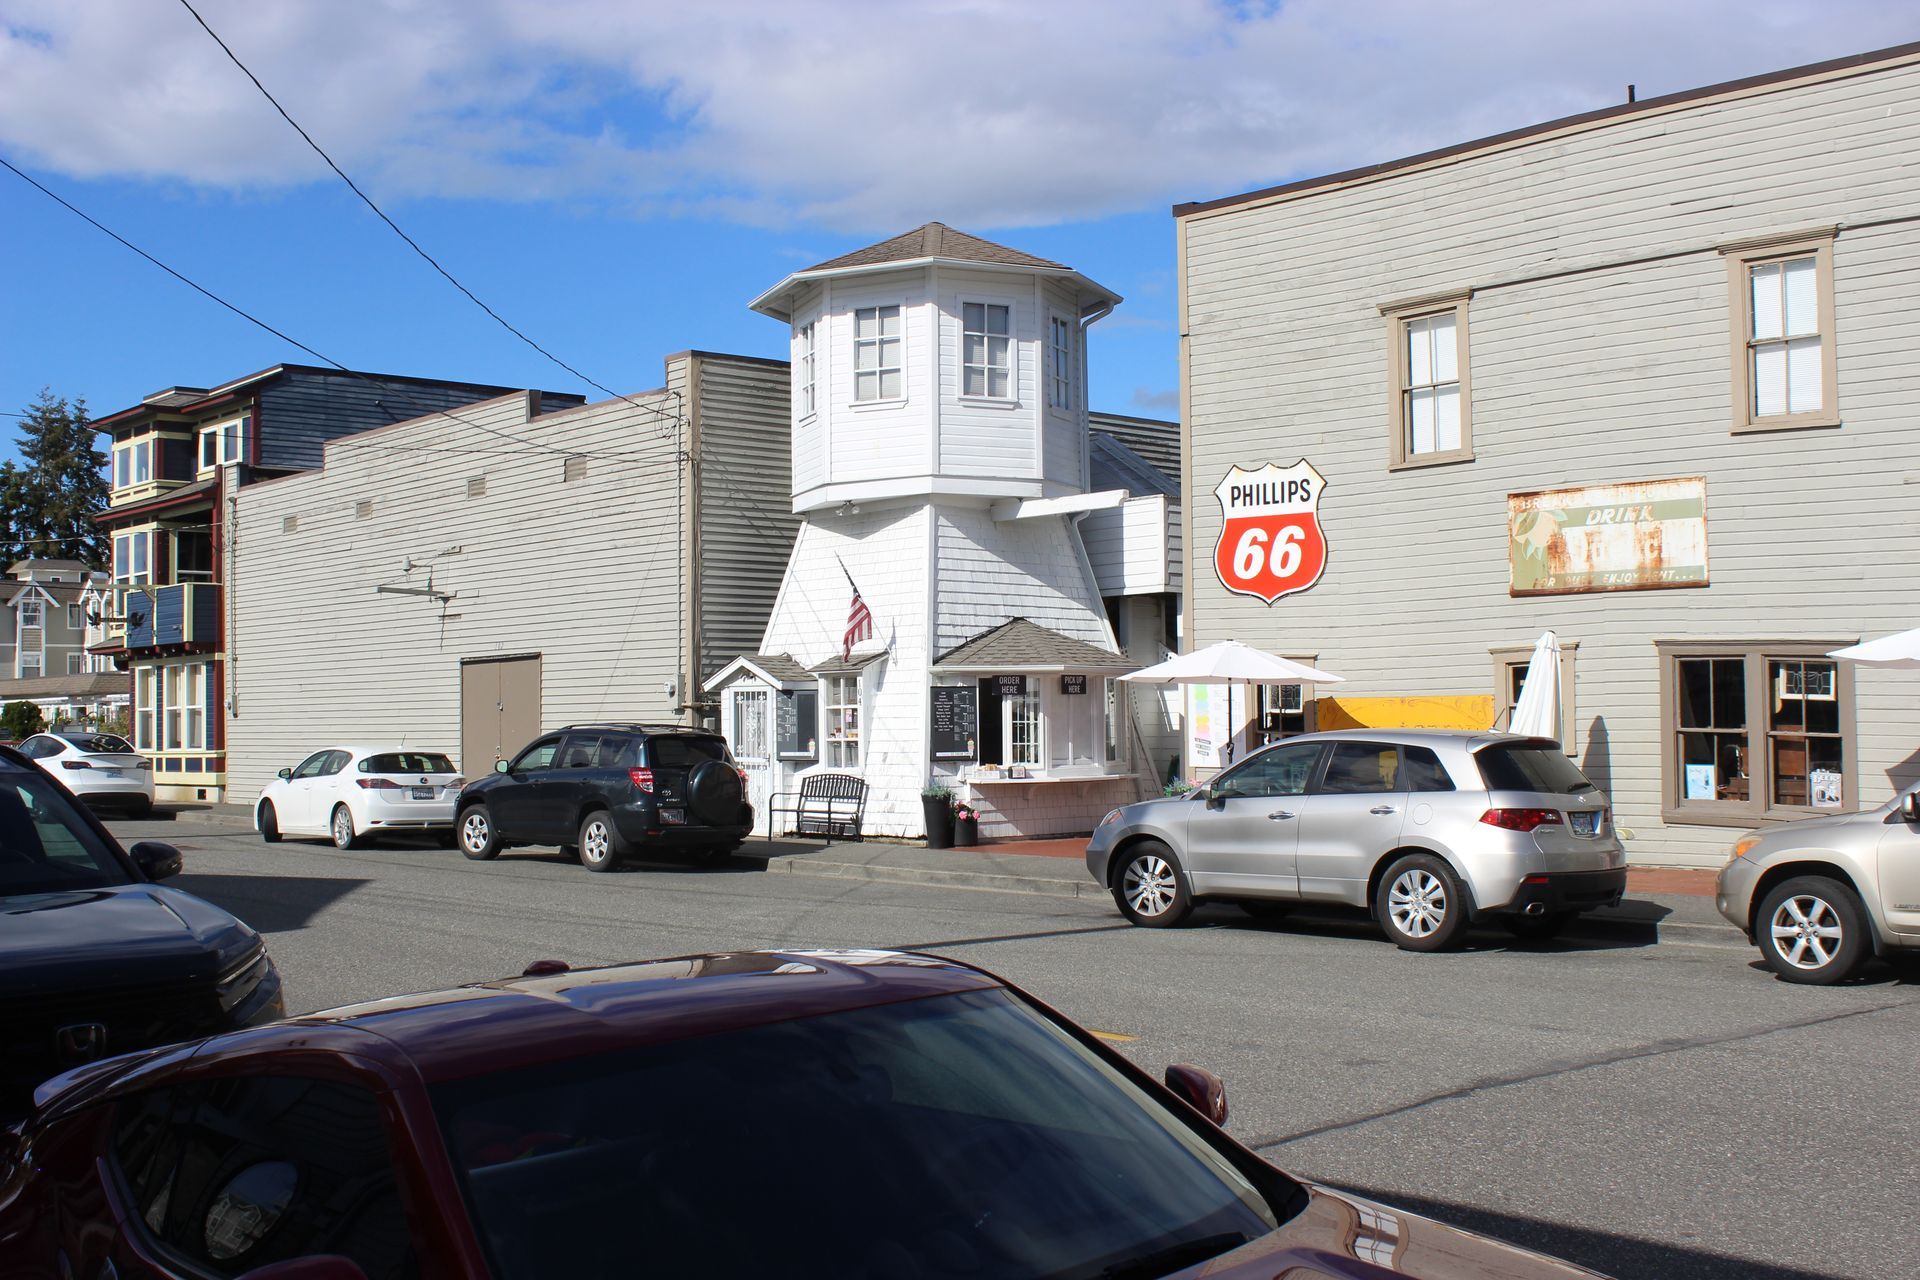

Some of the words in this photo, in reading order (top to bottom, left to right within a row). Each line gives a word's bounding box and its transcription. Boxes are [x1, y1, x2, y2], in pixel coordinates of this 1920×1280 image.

[1231, 478, 1311, 508] PHILLIPS
[1586, 505, 1656, 526] DRINK
[1233, 525, 1305, 580] 66
[999, 676, 1020, 685] ORDER
[1064, 676, 1076, 684] PICK
[1076, 676, 1084, 684] UP
[1001, 685, 1018, 694] HERE
[1068, 685, 1081, 693] HERE
